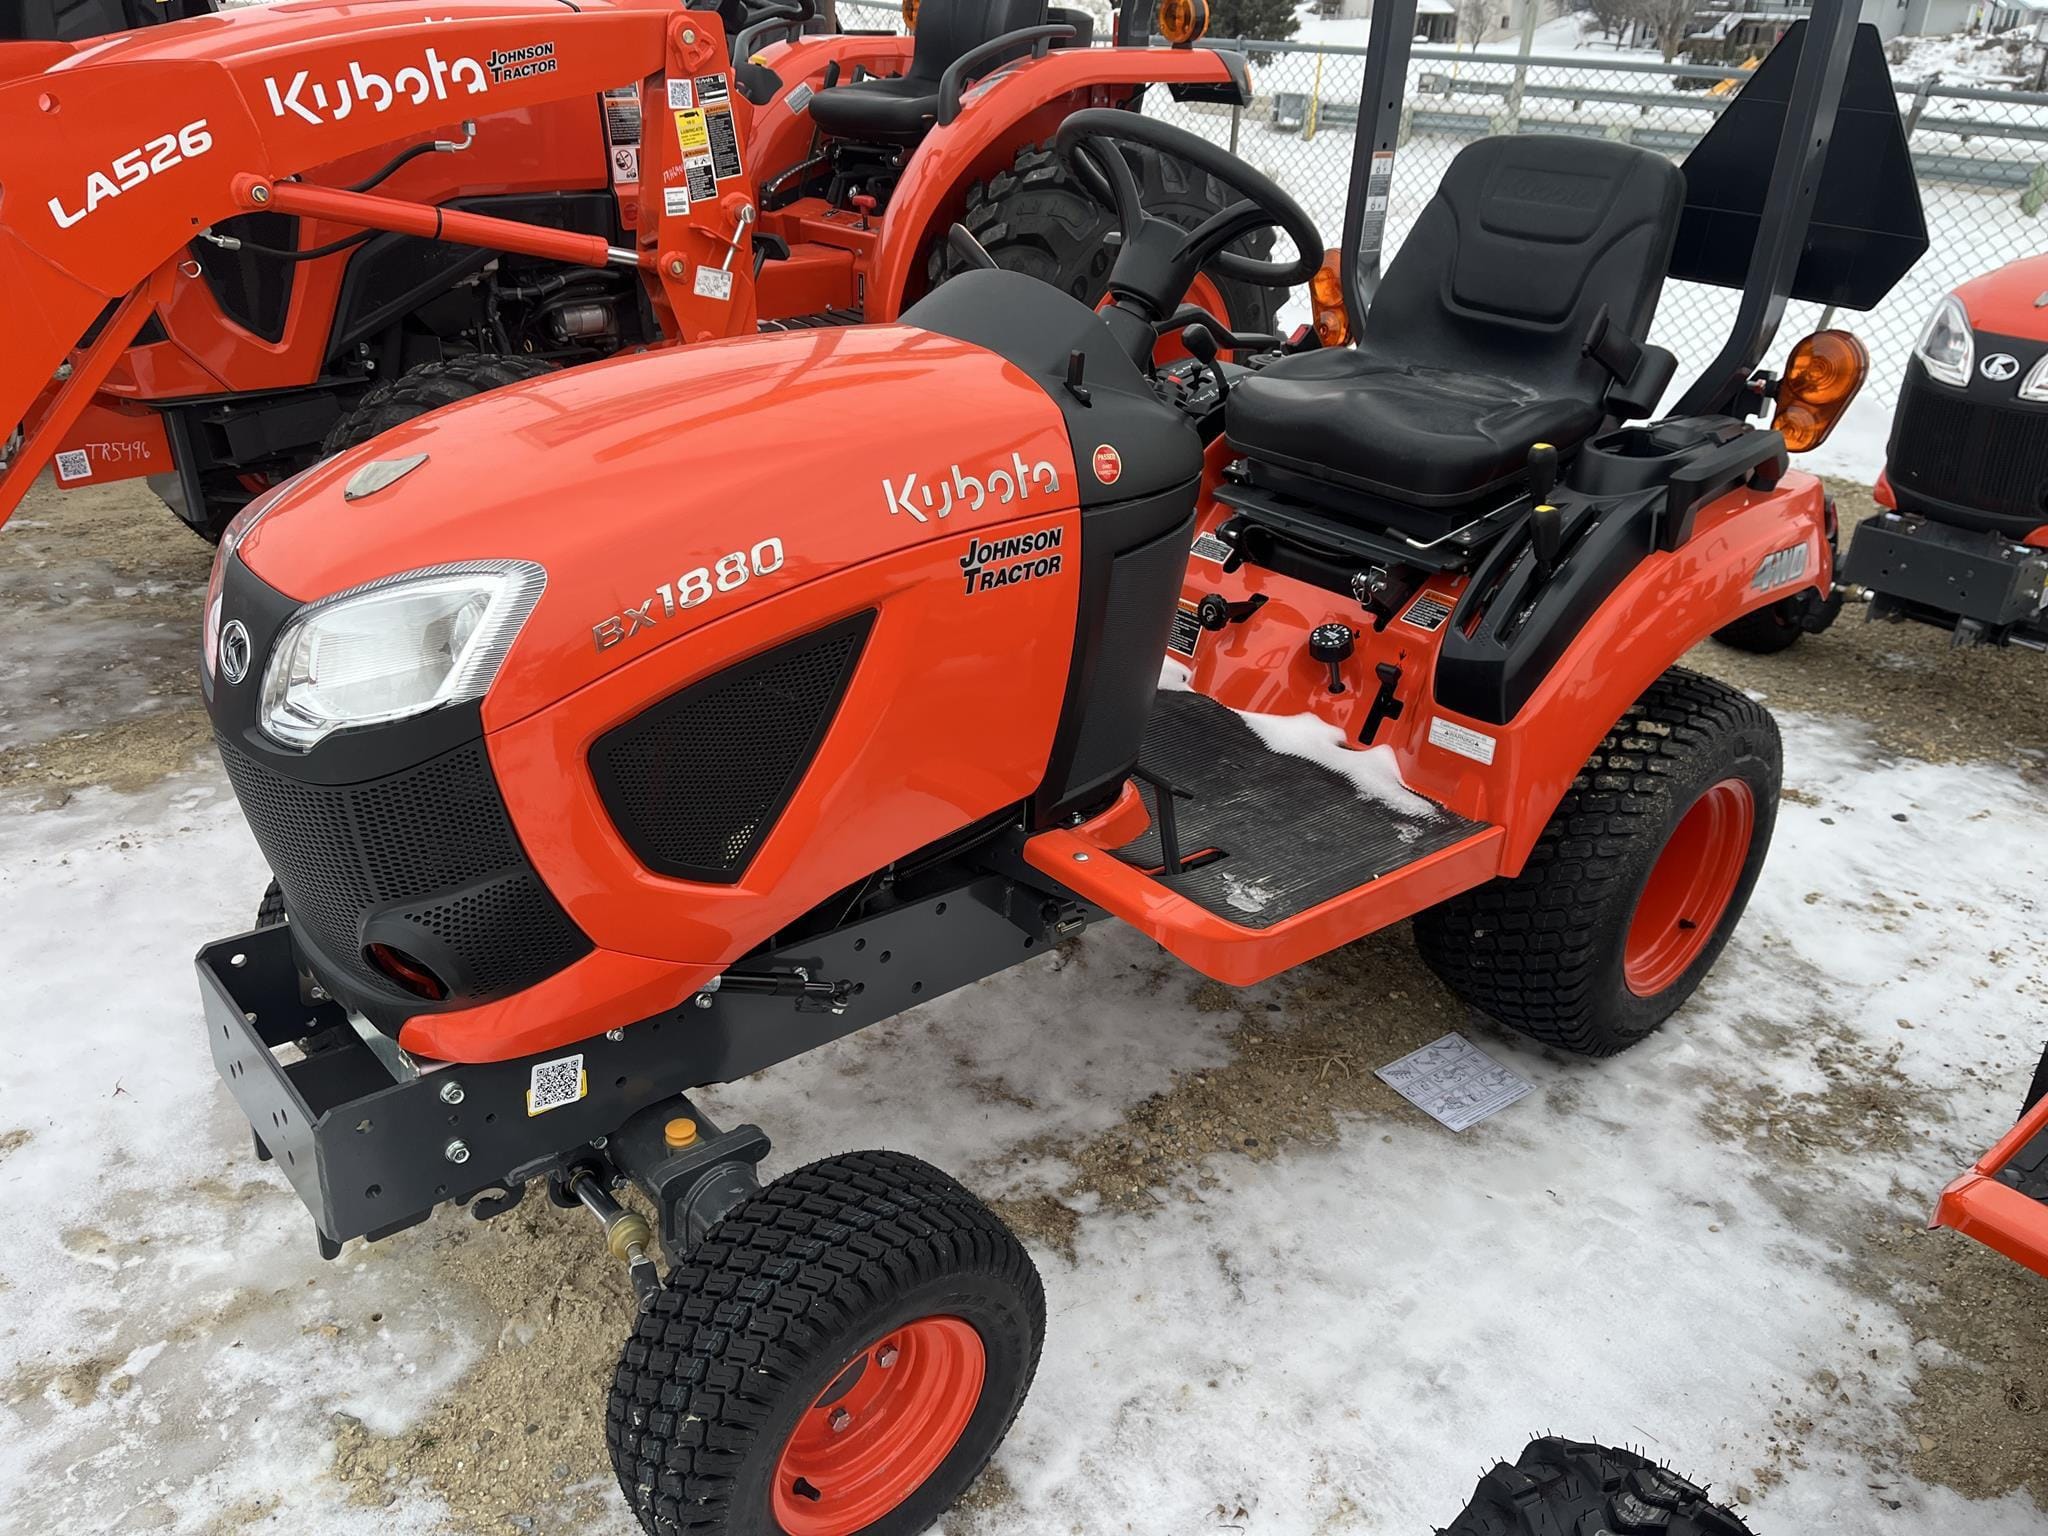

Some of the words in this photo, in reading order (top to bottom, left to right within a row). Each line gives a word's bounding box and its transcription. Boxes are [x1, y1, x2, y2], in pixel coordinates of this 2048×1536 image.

[486, 43, 554, 68] JOHNSON
[491, 58, 557, 84] TRACTOR
[264, 47, 488, 125] Kubota
[48, 118, 213, 229] LA526
[86, 441, 151, 462] TR5496
[882, 452, 1060, 523] Kubota
[960, 527, 1063, 569] JOHNSON
[592, 537, 785, 654] BX1880
[964, 555, 1062, 596] TRACTOR
